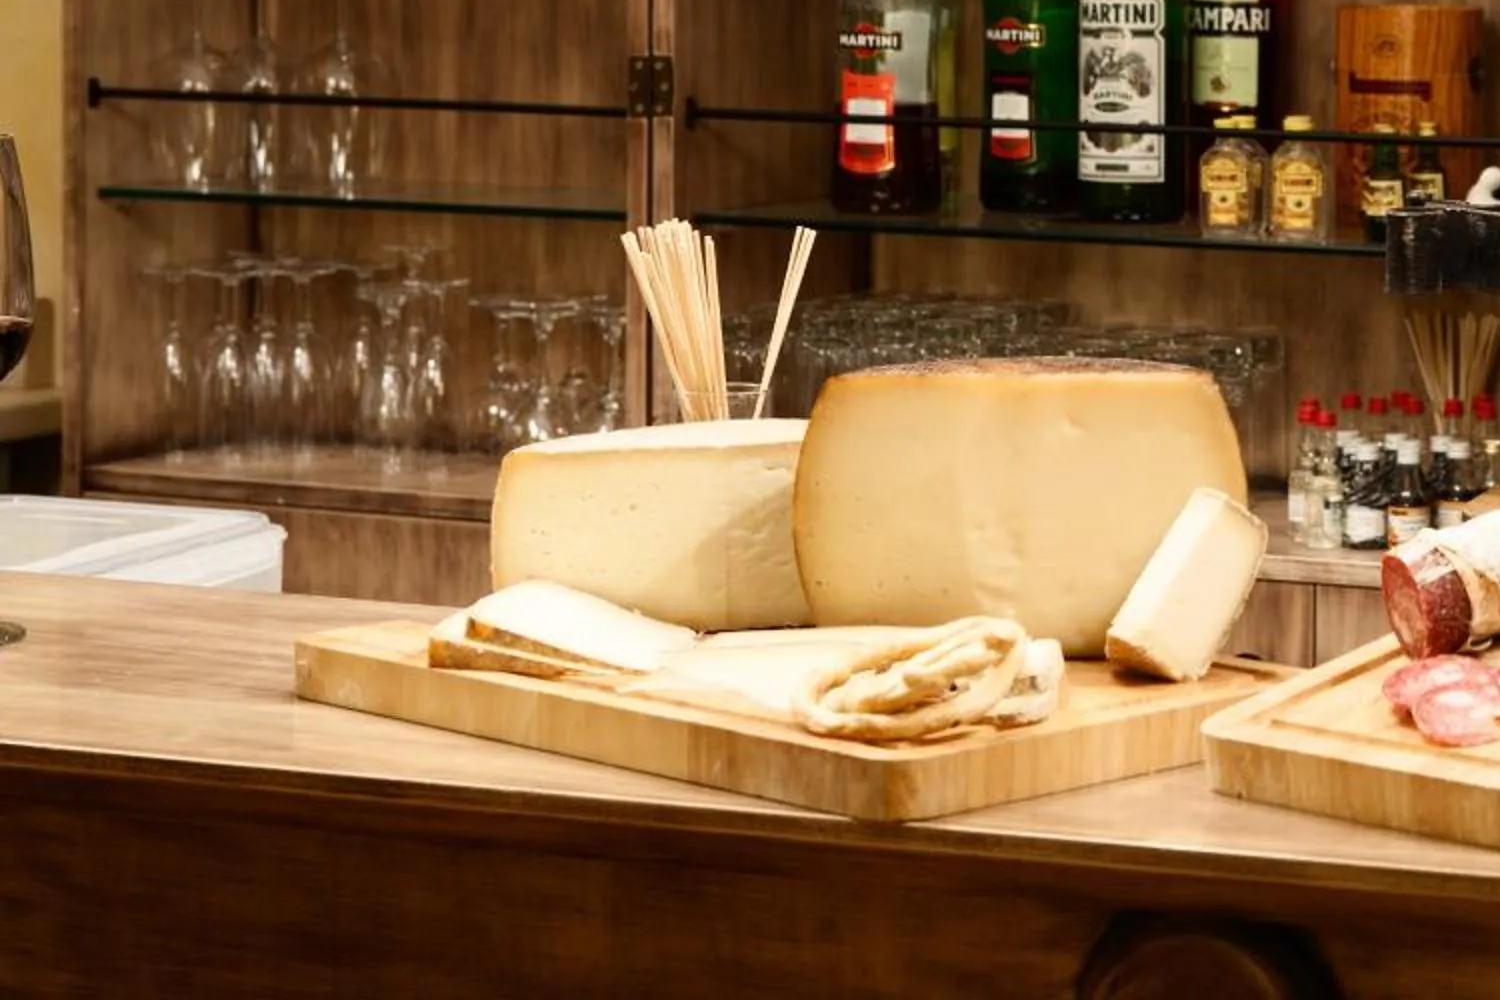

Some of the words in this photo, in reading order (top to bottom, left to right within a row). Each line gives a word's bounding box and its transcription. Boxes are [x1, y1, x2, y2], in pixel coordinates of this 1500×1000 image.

[1081, 2, 1156, 25] MARTINI
[1191, 6, 1271, 32] AMPARI
[839, 33, 899, 49] MARTINI
